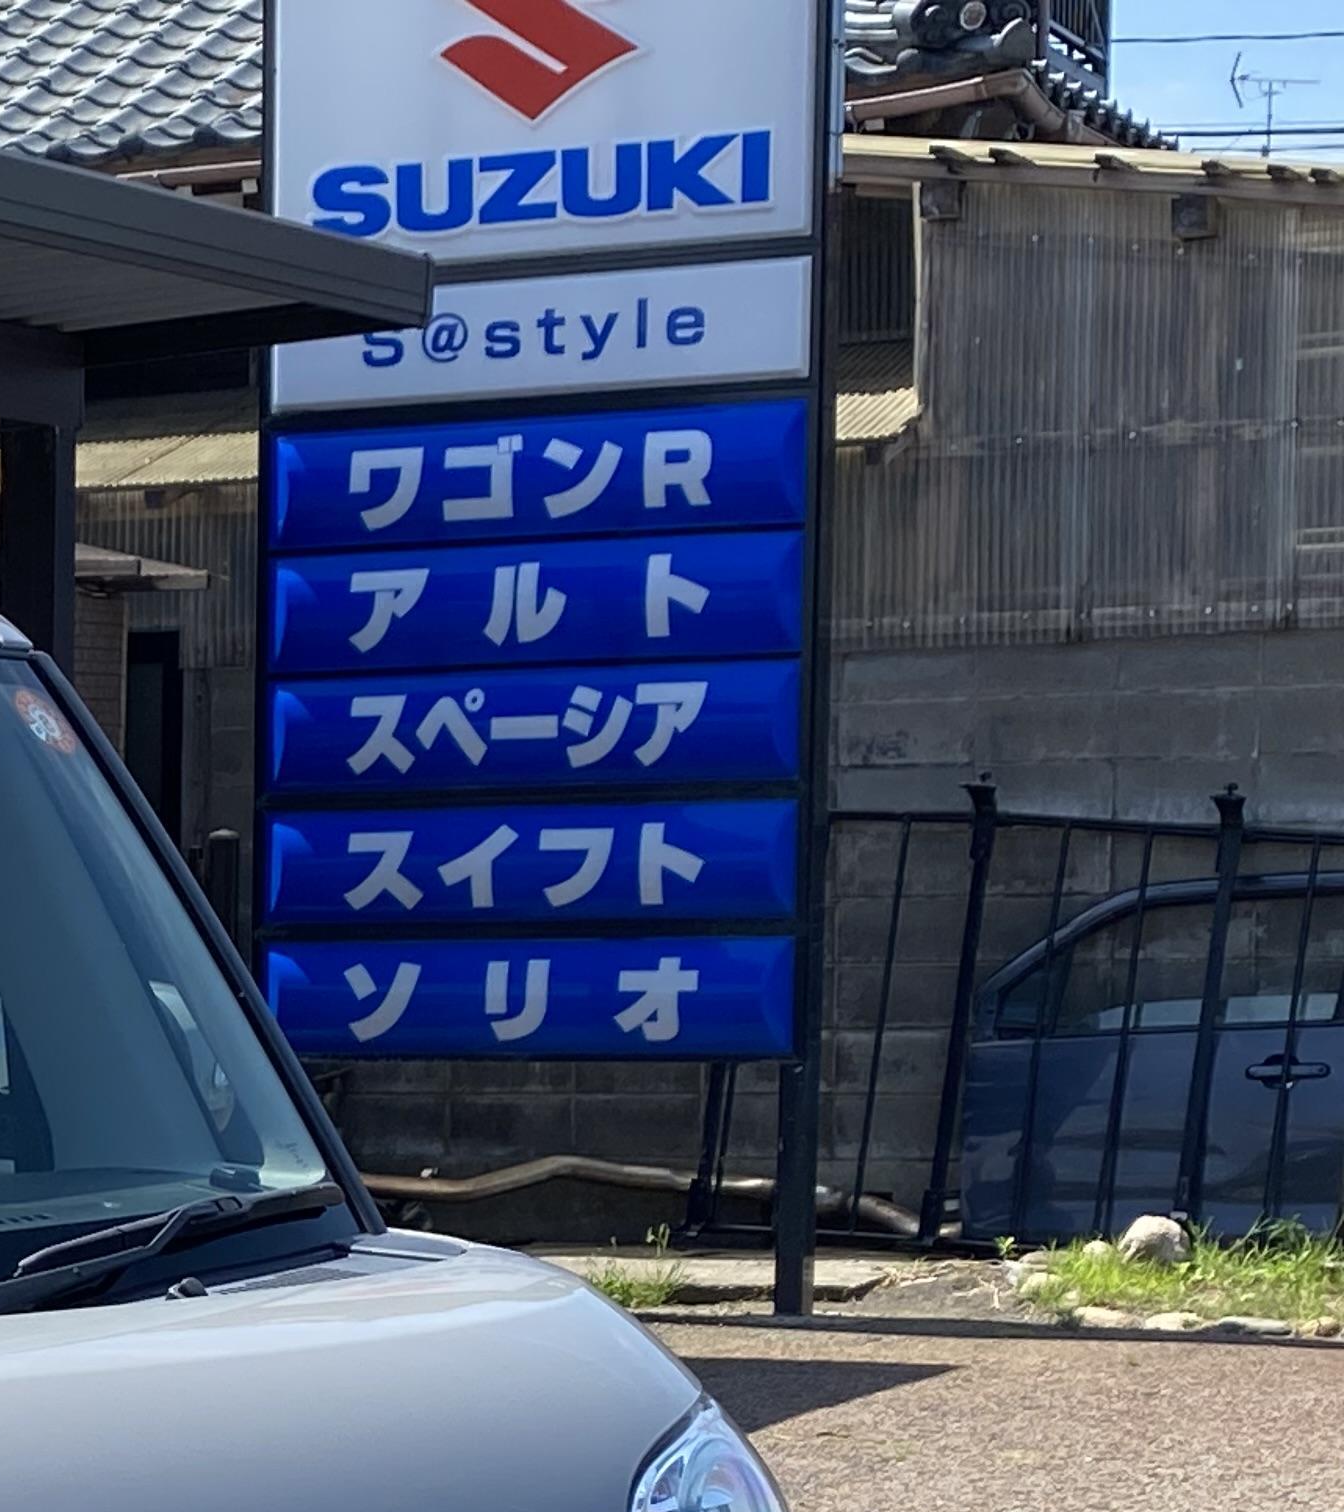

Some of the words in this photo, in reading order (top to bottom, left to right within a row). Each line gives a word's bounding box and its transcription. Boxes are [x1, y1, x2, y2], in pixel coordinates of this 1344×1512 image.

[313, 130, 771, 237] SUZUKI
[349, 430, 712, 531] ワゴンR
[349, 553, 710, 653] アルト
[346, 681, 708, 774] スペーシア
[344, 822, 705, 910] スイフト
[343, 957, 699, 1043] ソリオ
